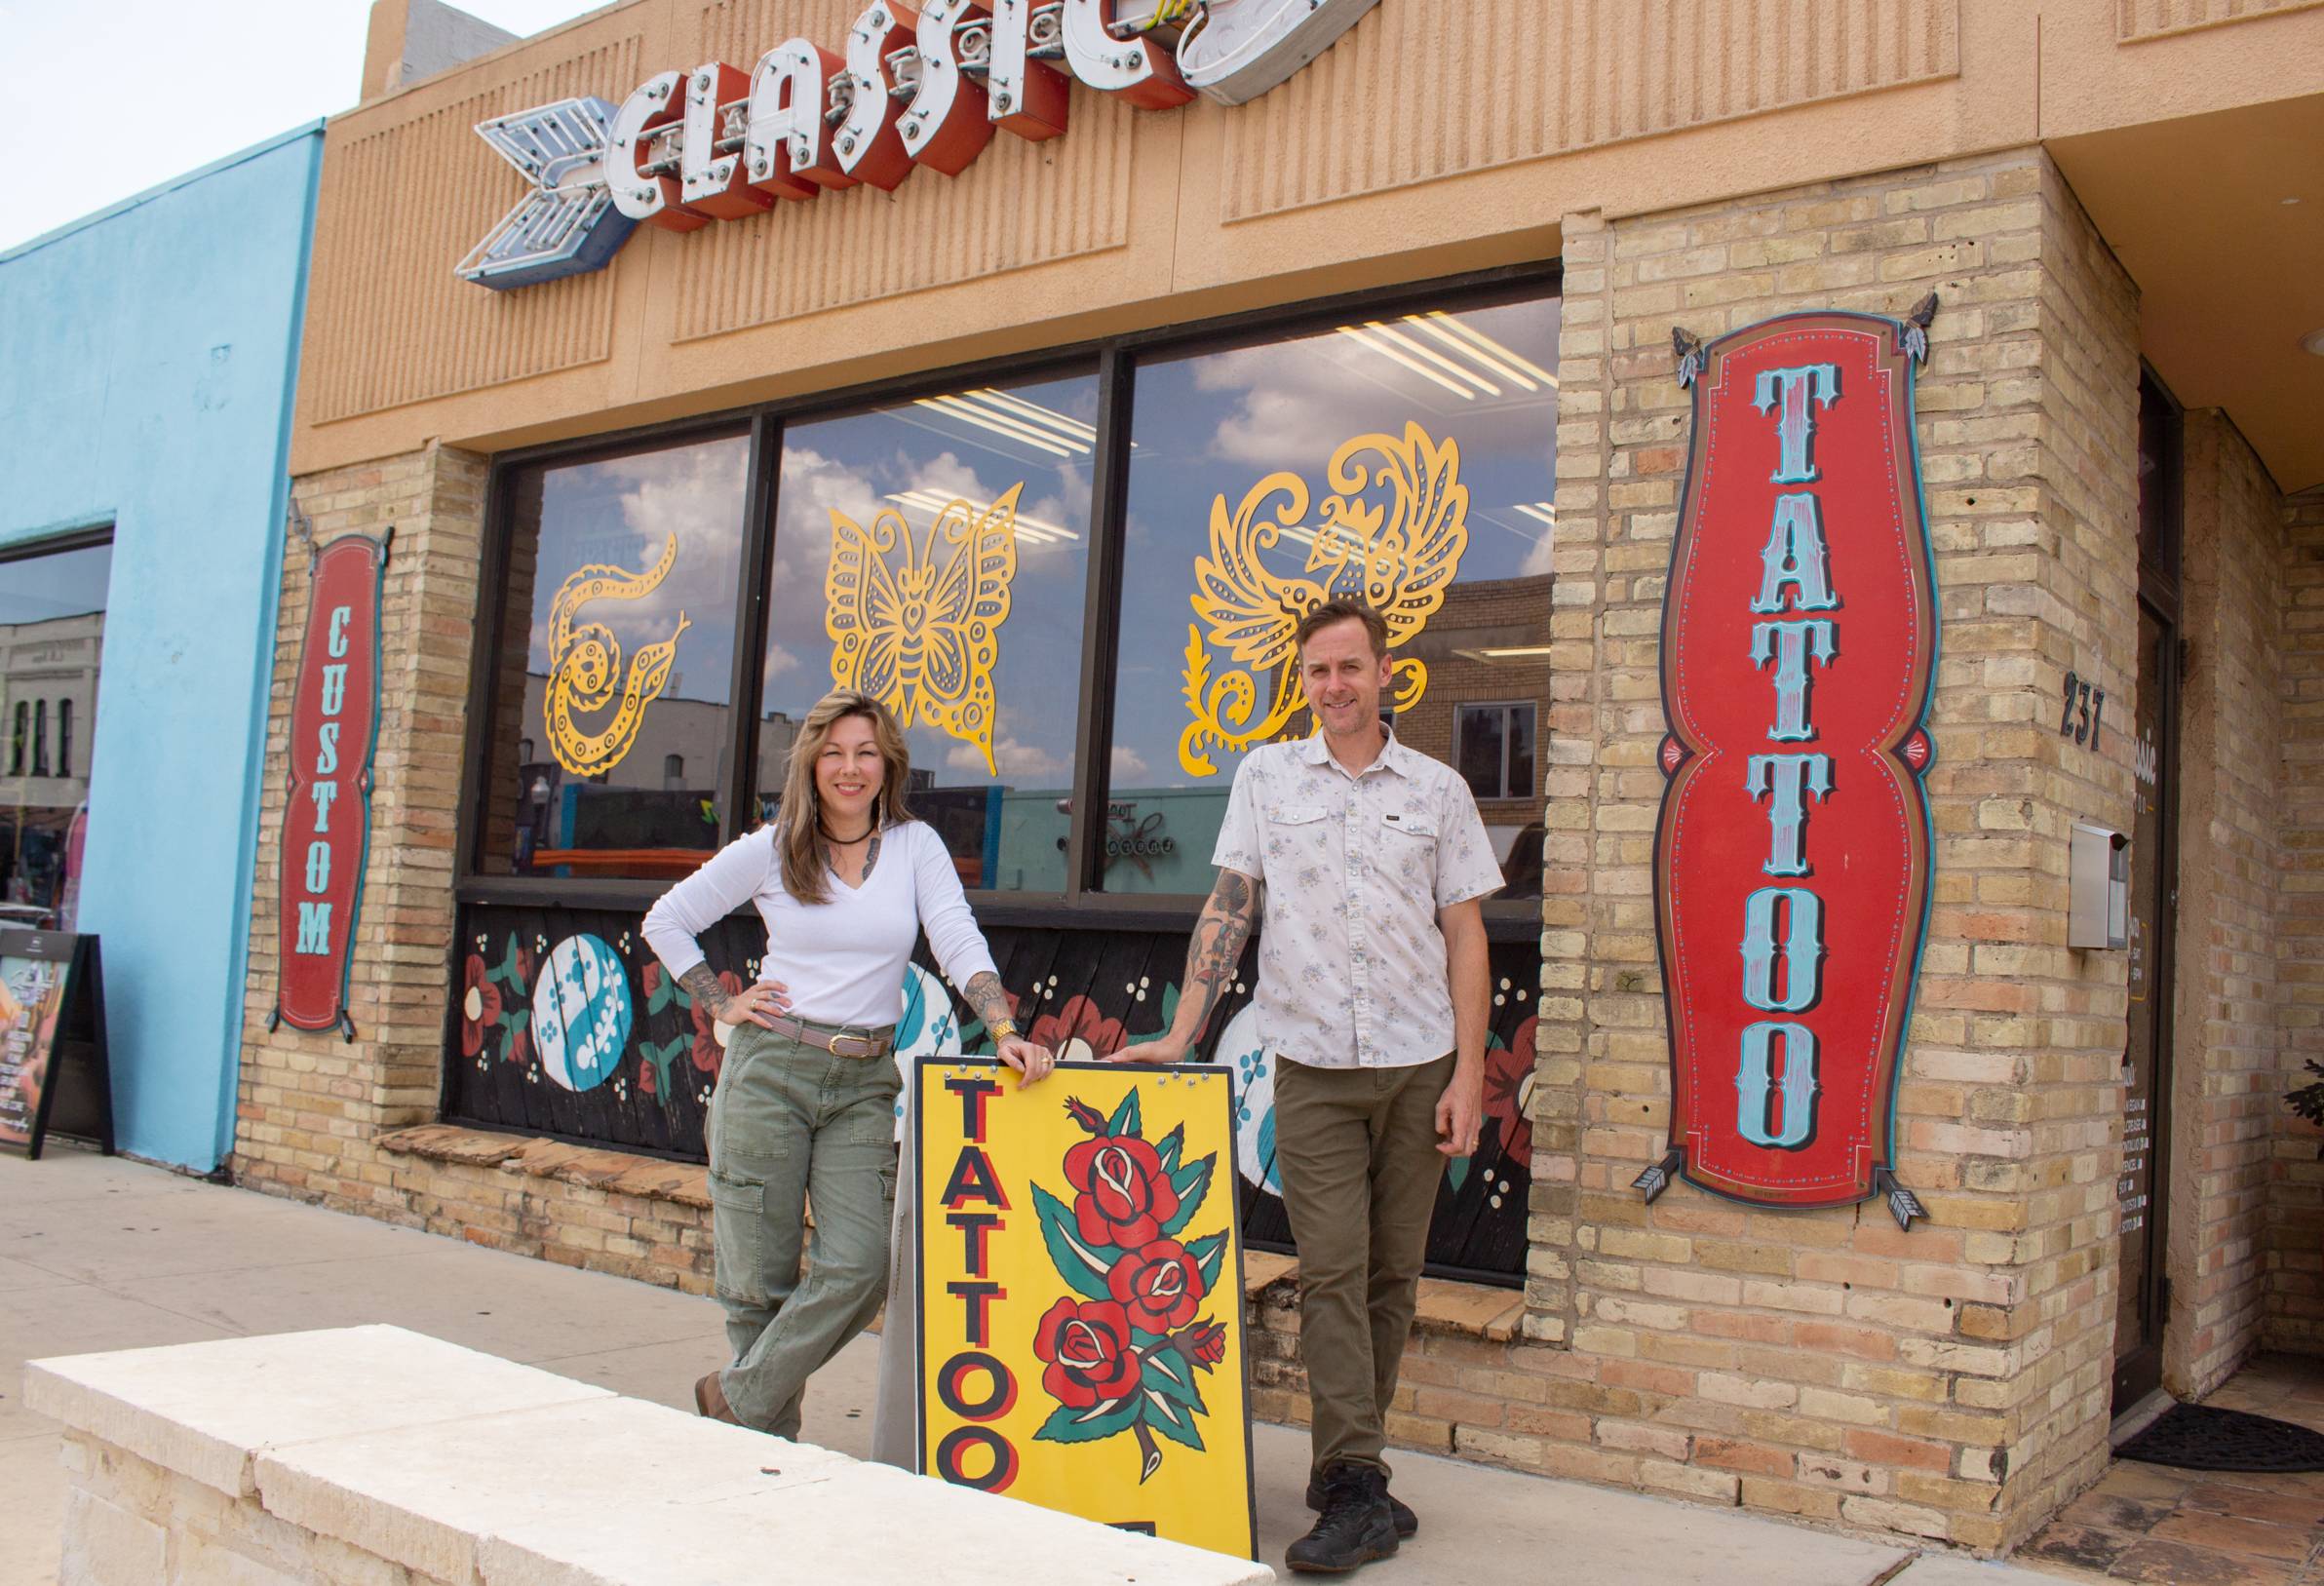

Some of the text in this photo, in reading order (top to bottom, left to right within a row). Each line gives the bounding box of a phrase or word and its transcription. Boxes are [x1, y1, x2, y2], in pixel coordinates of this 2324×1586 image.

[603, 0, 1160, 222] CLASSIC
[295, 605, 352, 955] CUSTOM
[1736, 362, 1840, 1151] TATTOO
[2060, 670, 2105, 752] 237
[936, 1078, 1020, 1495] TATTOO
